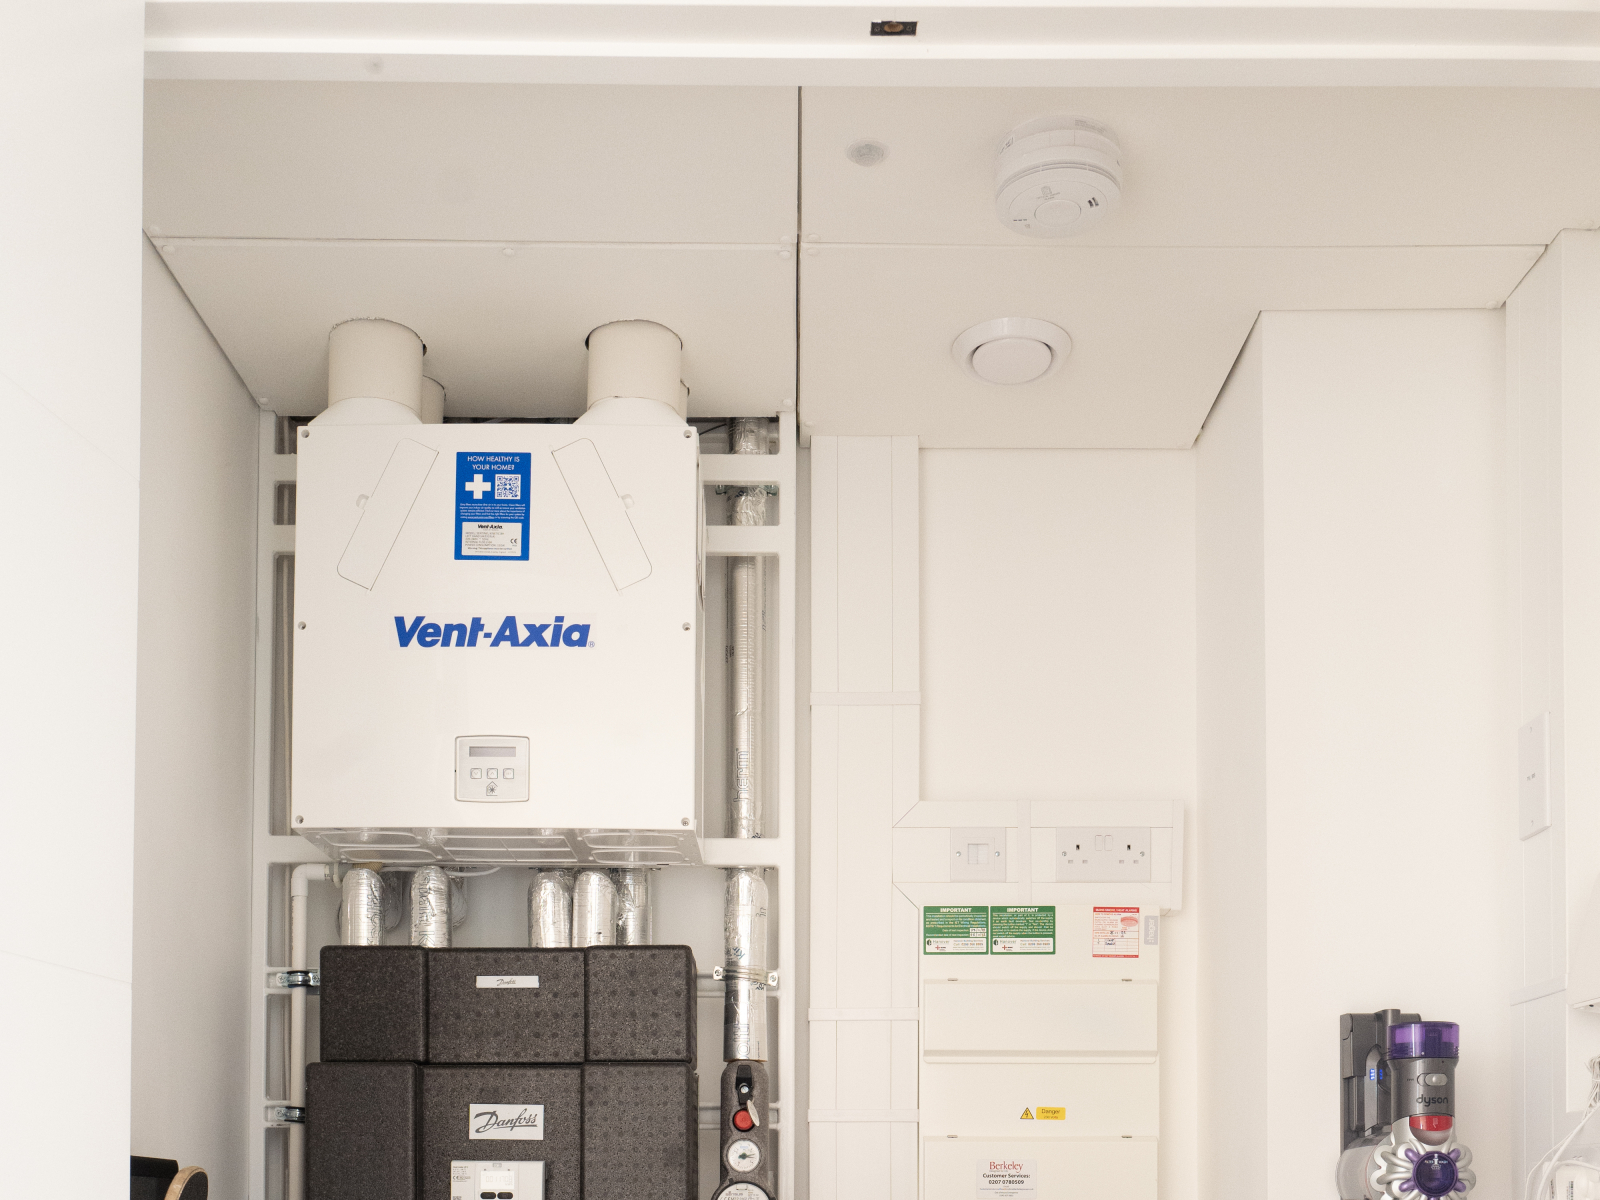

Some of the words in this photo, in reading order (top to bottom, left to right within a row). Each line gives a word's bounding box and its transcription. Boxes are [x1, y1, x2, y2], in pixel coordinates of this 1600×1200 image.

[1416, 1094, 1448, 1107] dyson
[474, 1108, 538, 1133] Danfoss
[990, 1161, 1023, 1173] Berkeley
